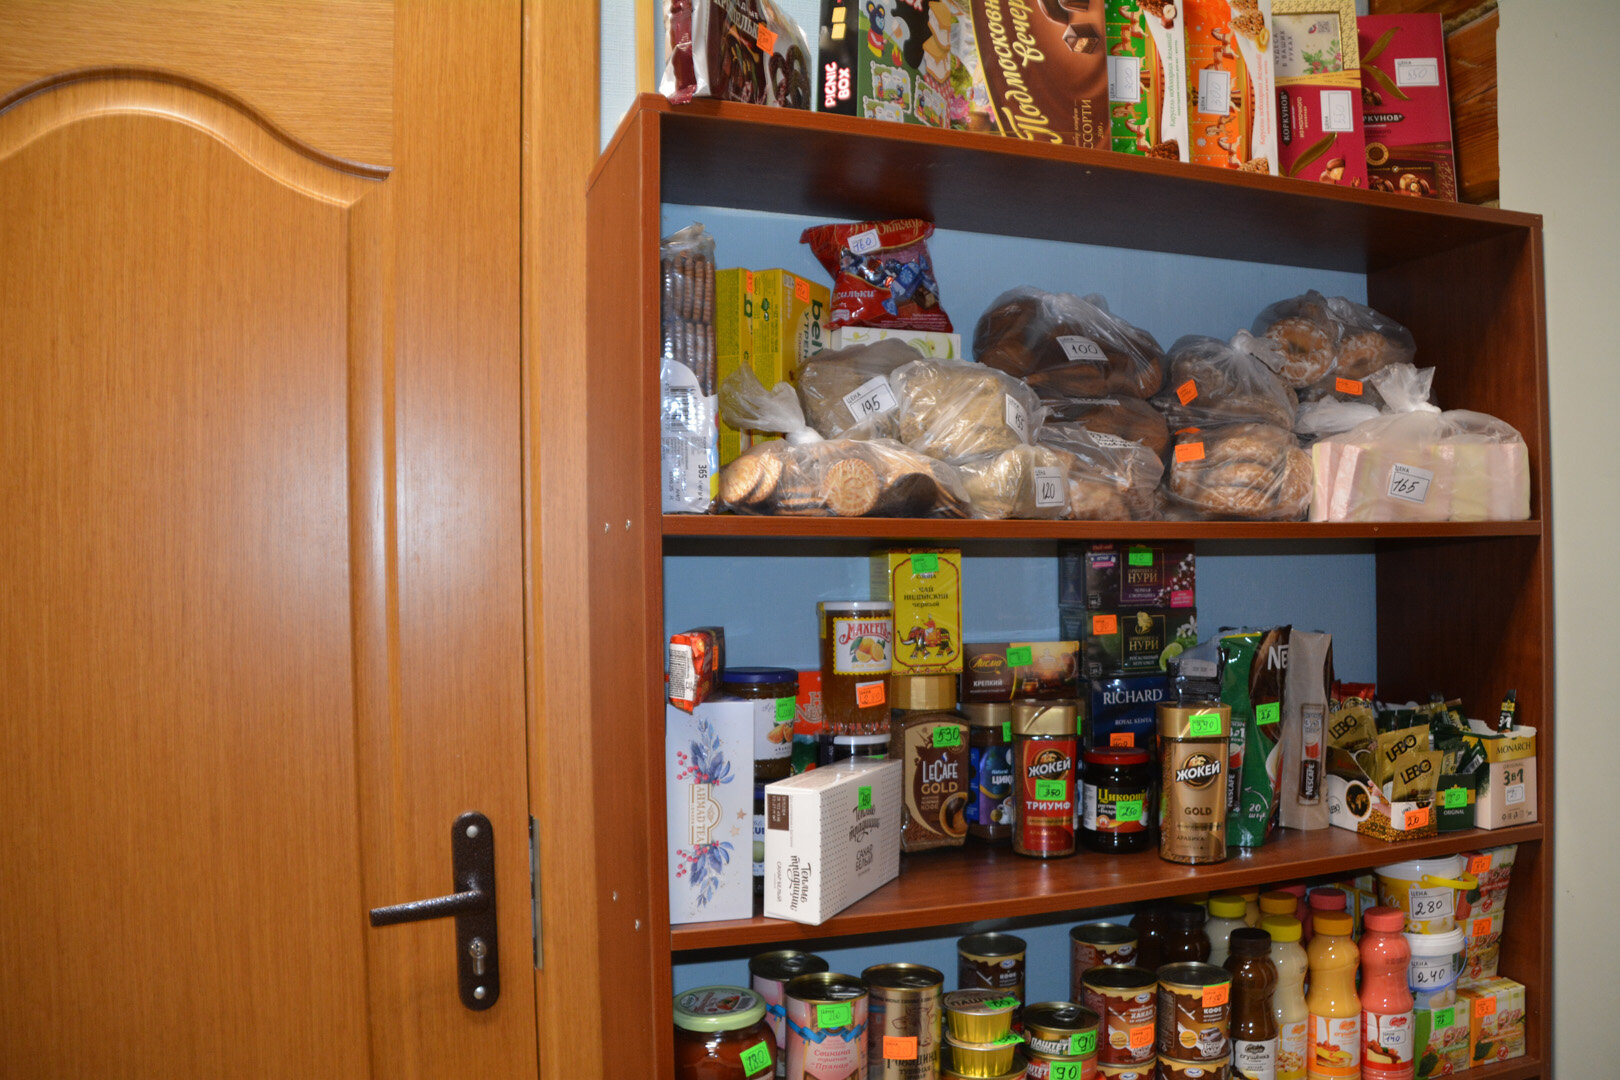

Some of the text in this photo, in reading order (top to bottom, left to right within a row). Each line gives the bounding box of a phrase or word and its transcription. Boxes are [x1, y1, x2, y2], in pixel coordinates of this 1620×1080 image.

[824, 61, 838, 108] PICNIC
[838, 67, 850, 101] BOX
[1280, 94, 1290, 141] КОРКУНОВ
[1070, 344, 1099, 356] 100
[861, 394, 880, 416] 195
[698, 464, 707, 479] 365
[1041, 479, 1056, 500] 120
[1392, 475, 1420, 494] 165
[1128, 573, 1158, 584] НУРИ
[1129, 640, 1160, 651] НУРИ
[973, 678, 1003, 687] КРЕПКИЙ
[1103, 688, 1163, 705] RICHARD
[1328, 715, 1358, 740] LEBO
[1495, 741, 1532, 755] MONARCH
[1028, 757, 1072, 778] ЖОКЕЙ
[1176, 760, 1221, 782] ЖОКЕЙ
[1400, 759, 1432, 785] LEBO
[920, 782, 958, 795] GOLD
[1026, 800, 1071, 811] ТРИУМФ
[1184, 806, 1212, 816] GOLD
[1250, 804, 1262, 812] 20
[696, 786, 706, 843] AHMAD TEA
[1415, 900, 1443, 917] 280
[1416, 968, 1445, 983] 240
[1078, 1034, 1095, 1052] 90
[1055, 1065, 1078, 1080] 90
